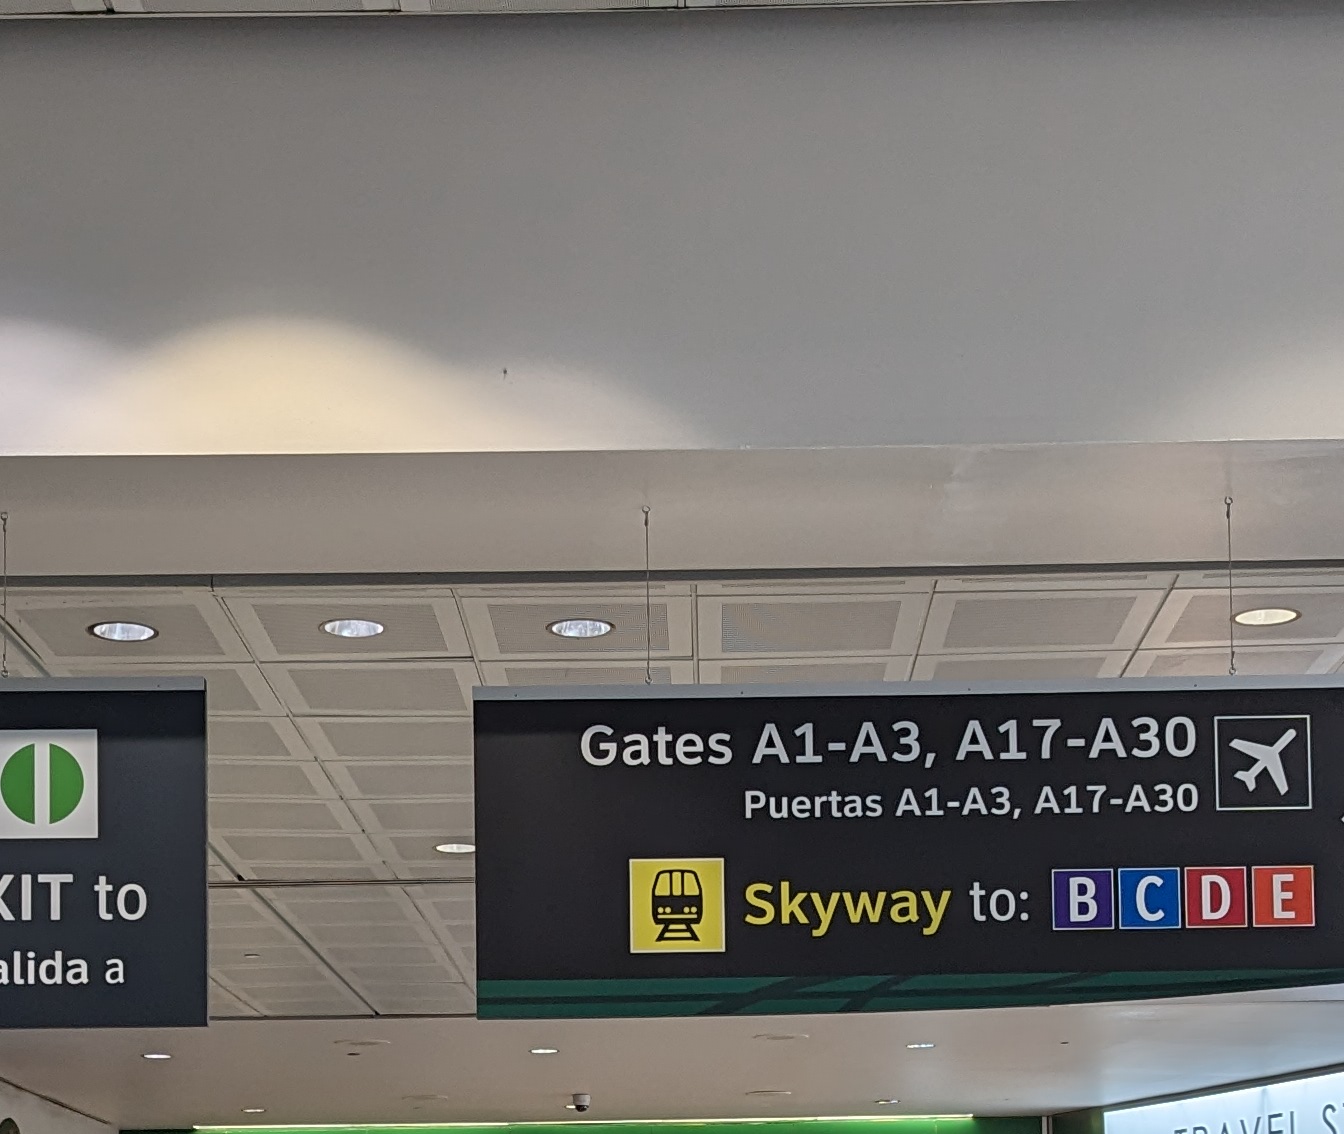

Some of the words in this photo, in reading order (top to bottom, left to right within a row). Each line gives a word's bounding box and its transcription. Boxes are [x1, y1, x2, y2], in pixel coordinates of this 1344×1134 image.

[581, 725, 732, 766] Gates
[752, 721, 935, 768] A1-A3,
[956, 717, 1195, 760] A17-A30
[745, 791, 882, 818] Puertas
[896, 787, 1021, 819] A1-A3,
[1035, 784, 1198, 813] A17-A30
[93, 876, 147, 921] to
[745, 882, 952, 936] Skyway
[969, 882, 1029, 921] to:
[1070, 877, 1098, 921] B
[1137, 876, 1164, 921] C
[1202, 875, 1231, 919] D
[1273, 875, 1296, 918] E
[105, 958, 125, 985] a
